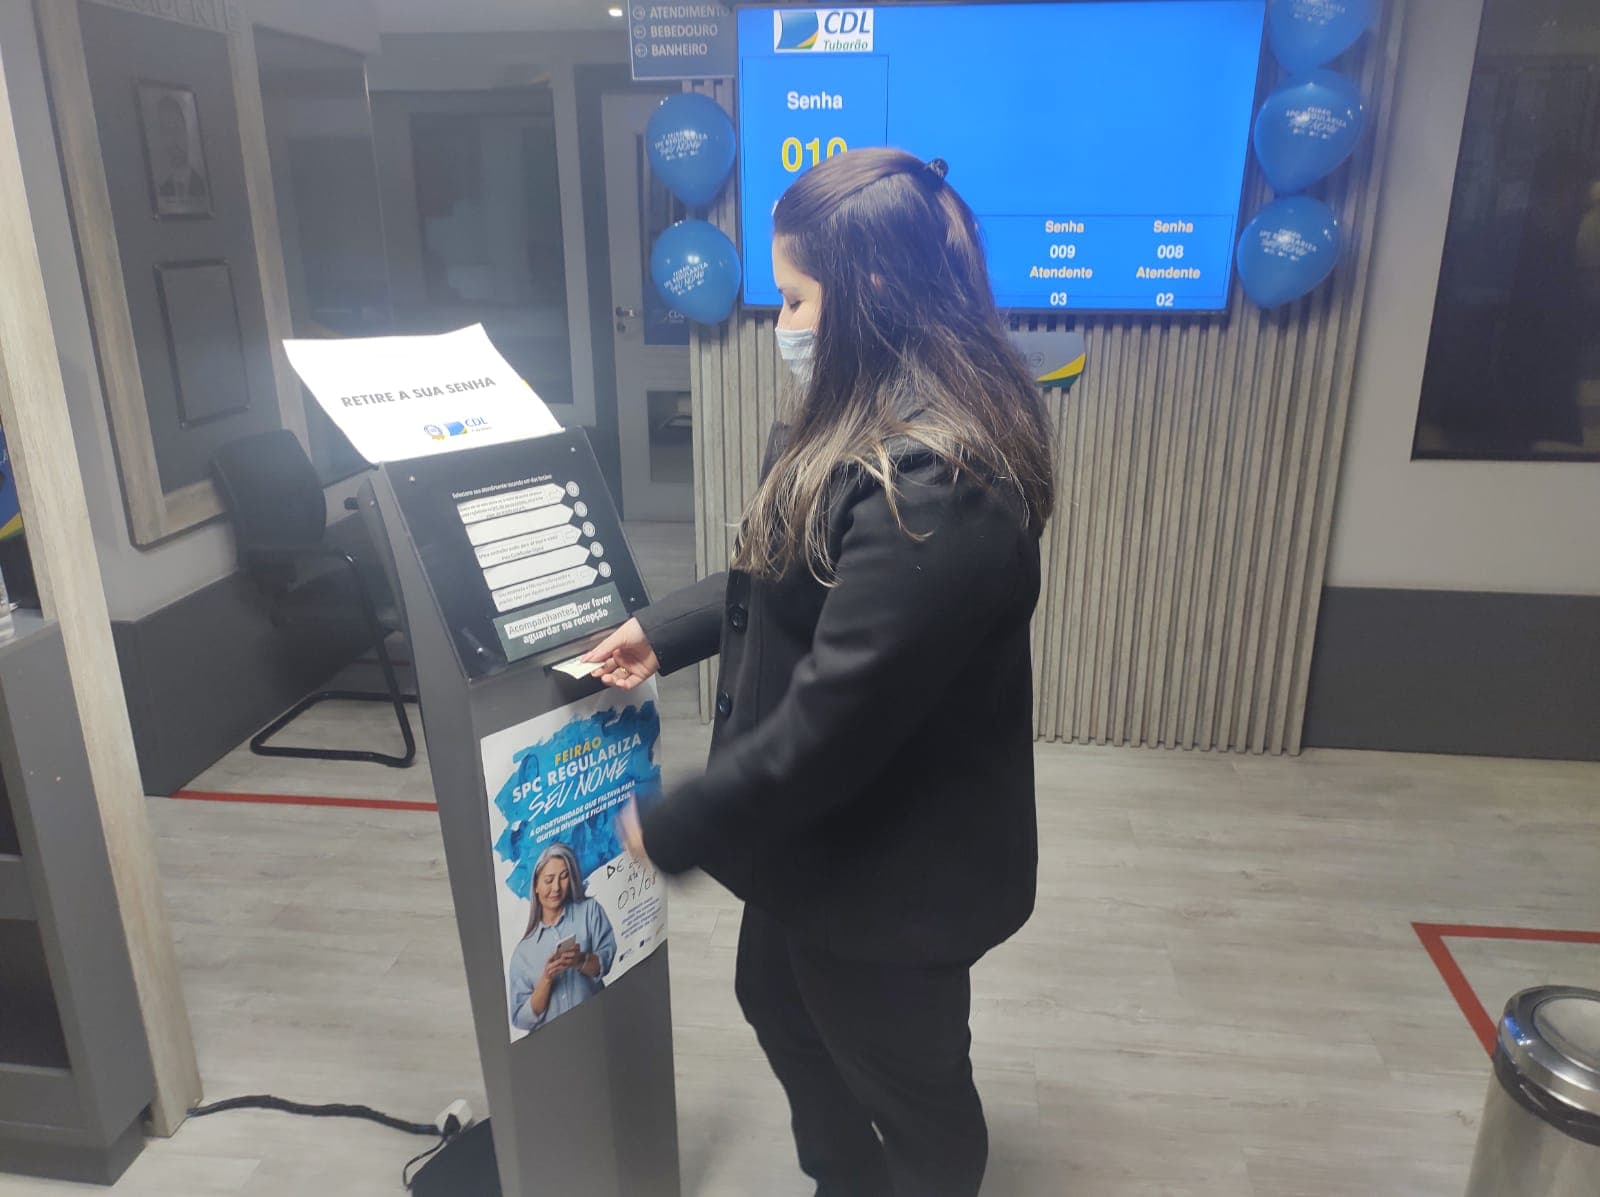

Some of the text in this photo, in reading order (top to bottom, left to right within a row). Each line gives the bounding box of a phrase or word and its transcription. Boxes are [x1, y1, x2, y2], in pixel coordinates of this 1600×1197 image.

[824, 11, 870, 34] CDL
[650, 23, 718, 38] BEBEDOURO
[651, 43, 708, 57] BANHEIRO
[787, 90, 843, 110] Senha
[1045, 220, 1084, 233] Senha
[1153, 220, 1193, 233] Senha
[1049, 245, 1076, 259] 009
[1157, 245, 1184, 259] 008
[1029, 266, 1093, 279] Atendente
[1136, 266, 1200, 279] Atendente
[1050, 292, 1068, 306] 03
[1156, 293, 1174, 307] 02
[340, 377, 496, 408] RETIRE A SUA SENHA
[578, 601, 591, 614] por
[592, 594, 612, 608] favor
[523, 608, 608, 645] aguardar na recepção
[555, 736, 602, 767] FEIRÃO
[512, 733, 641, 804] SPC REGULARIZA
[528, 751, 632, 822] SEU NOME
[535, 805, 584, 834] OPORTUNIDADE
